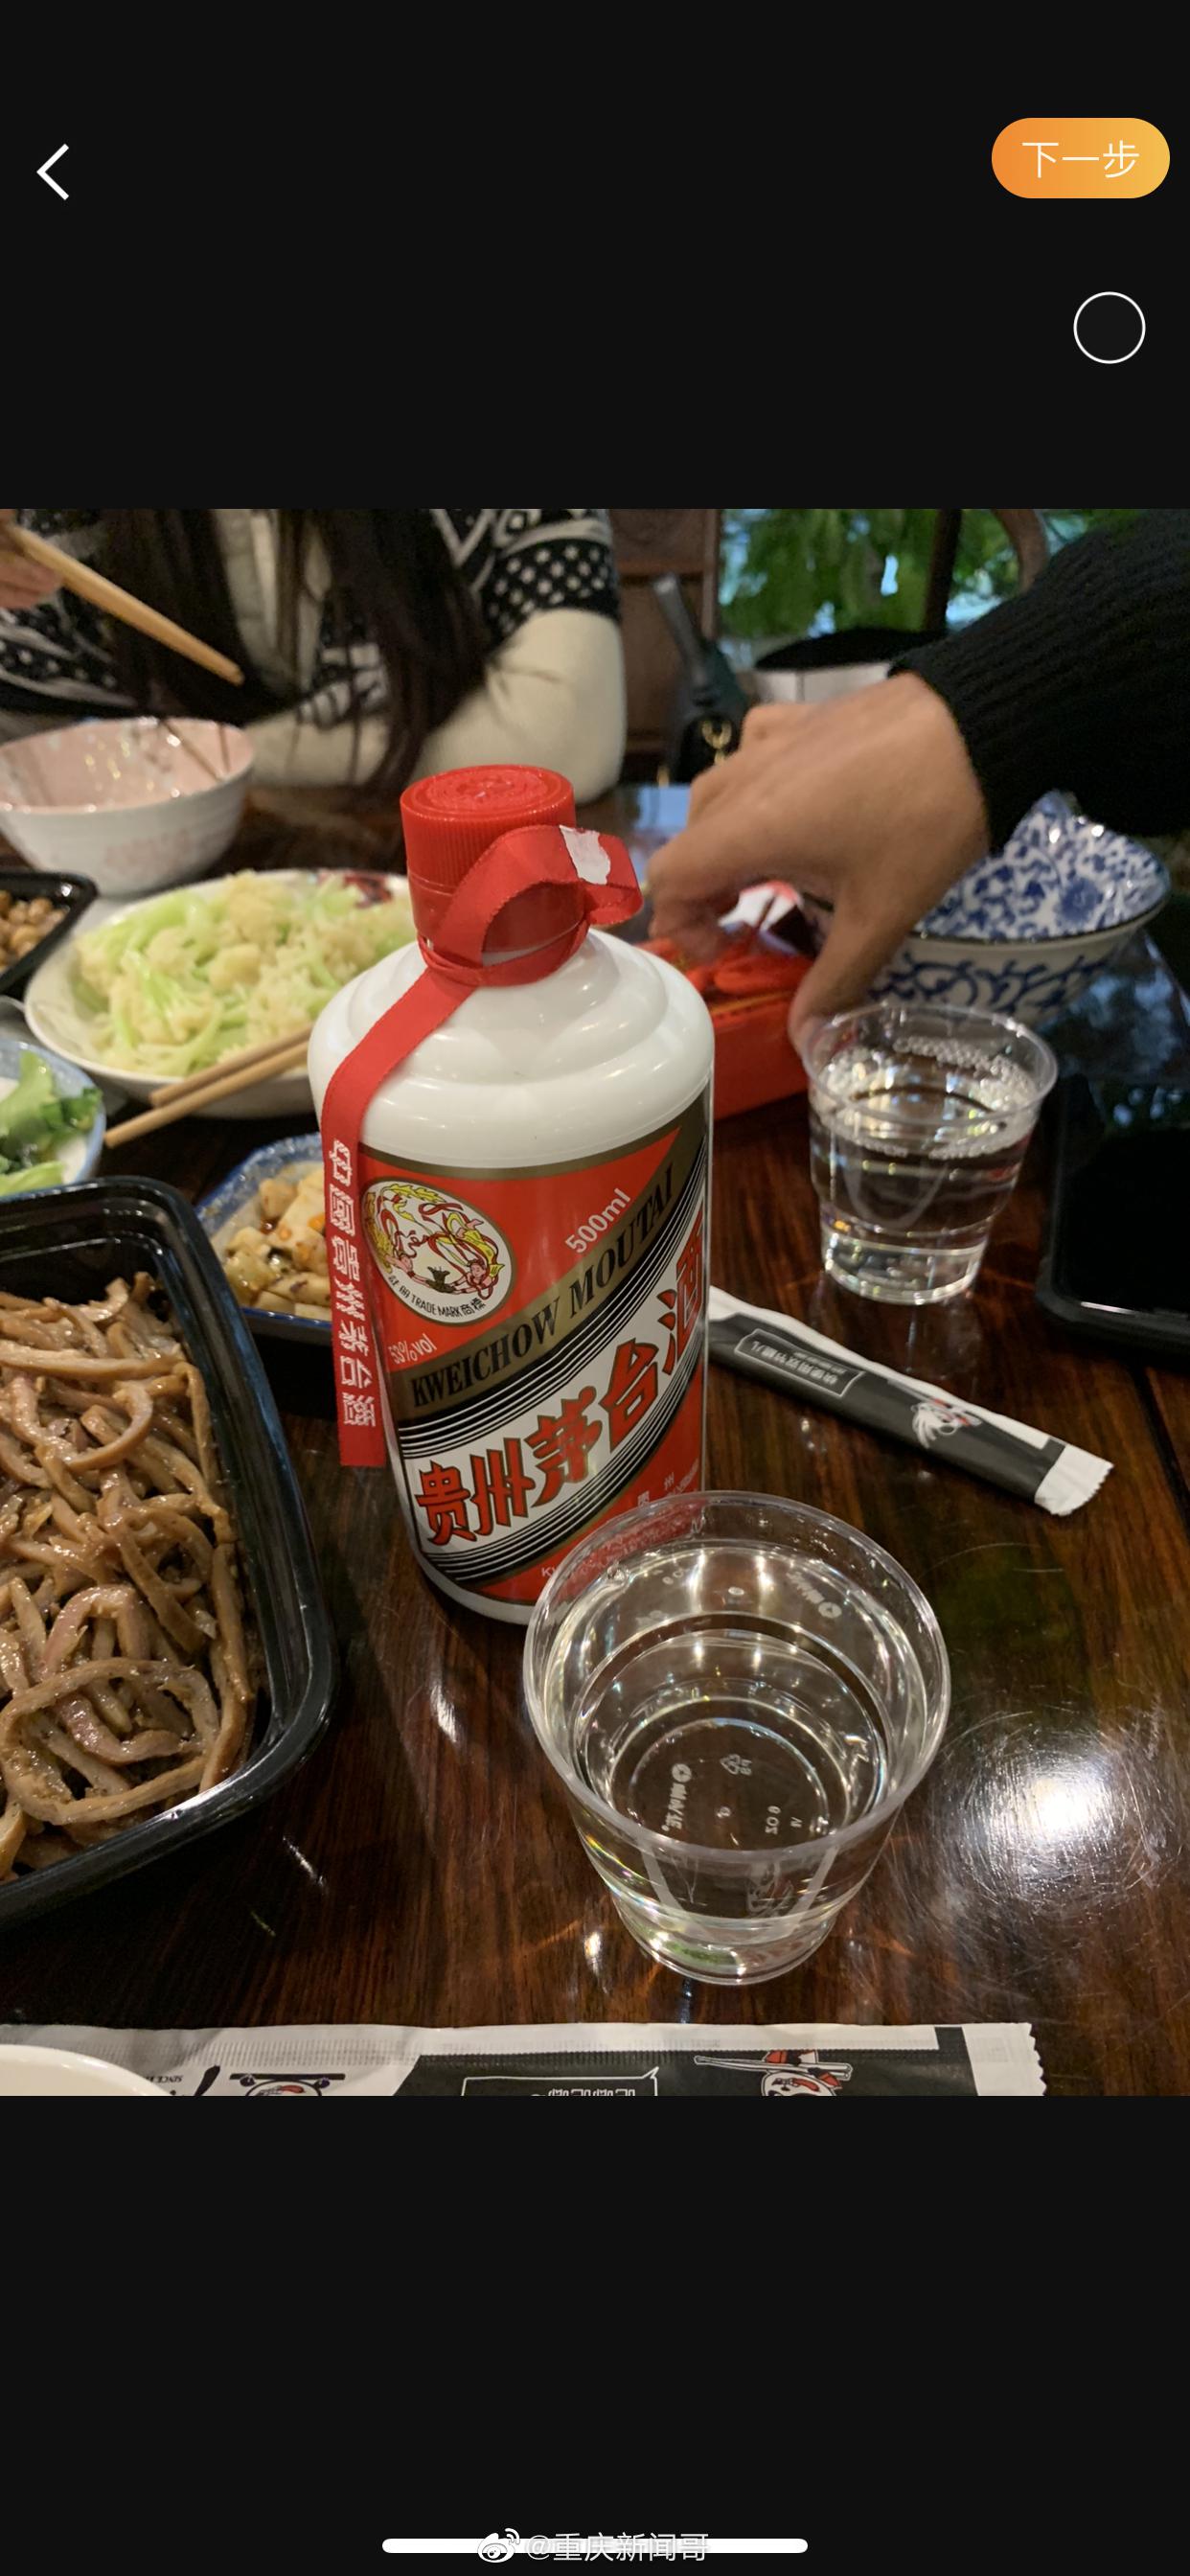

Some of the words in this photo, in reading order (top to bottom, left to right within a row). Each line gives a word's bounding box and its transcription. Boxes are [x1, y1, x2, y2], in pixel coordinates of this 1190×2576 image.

[410, 1296, 561, 1408] KWEICHOW
[568, 1162, 674, 1320] MOUTAI
[564, 1188, 631, 1254] 500ml
[410, 1294, 438, 1316] TRADE
[438, 1305, 461, 1318] MARK
[414, 1200, 705, 1547] 贵州茅台酒
